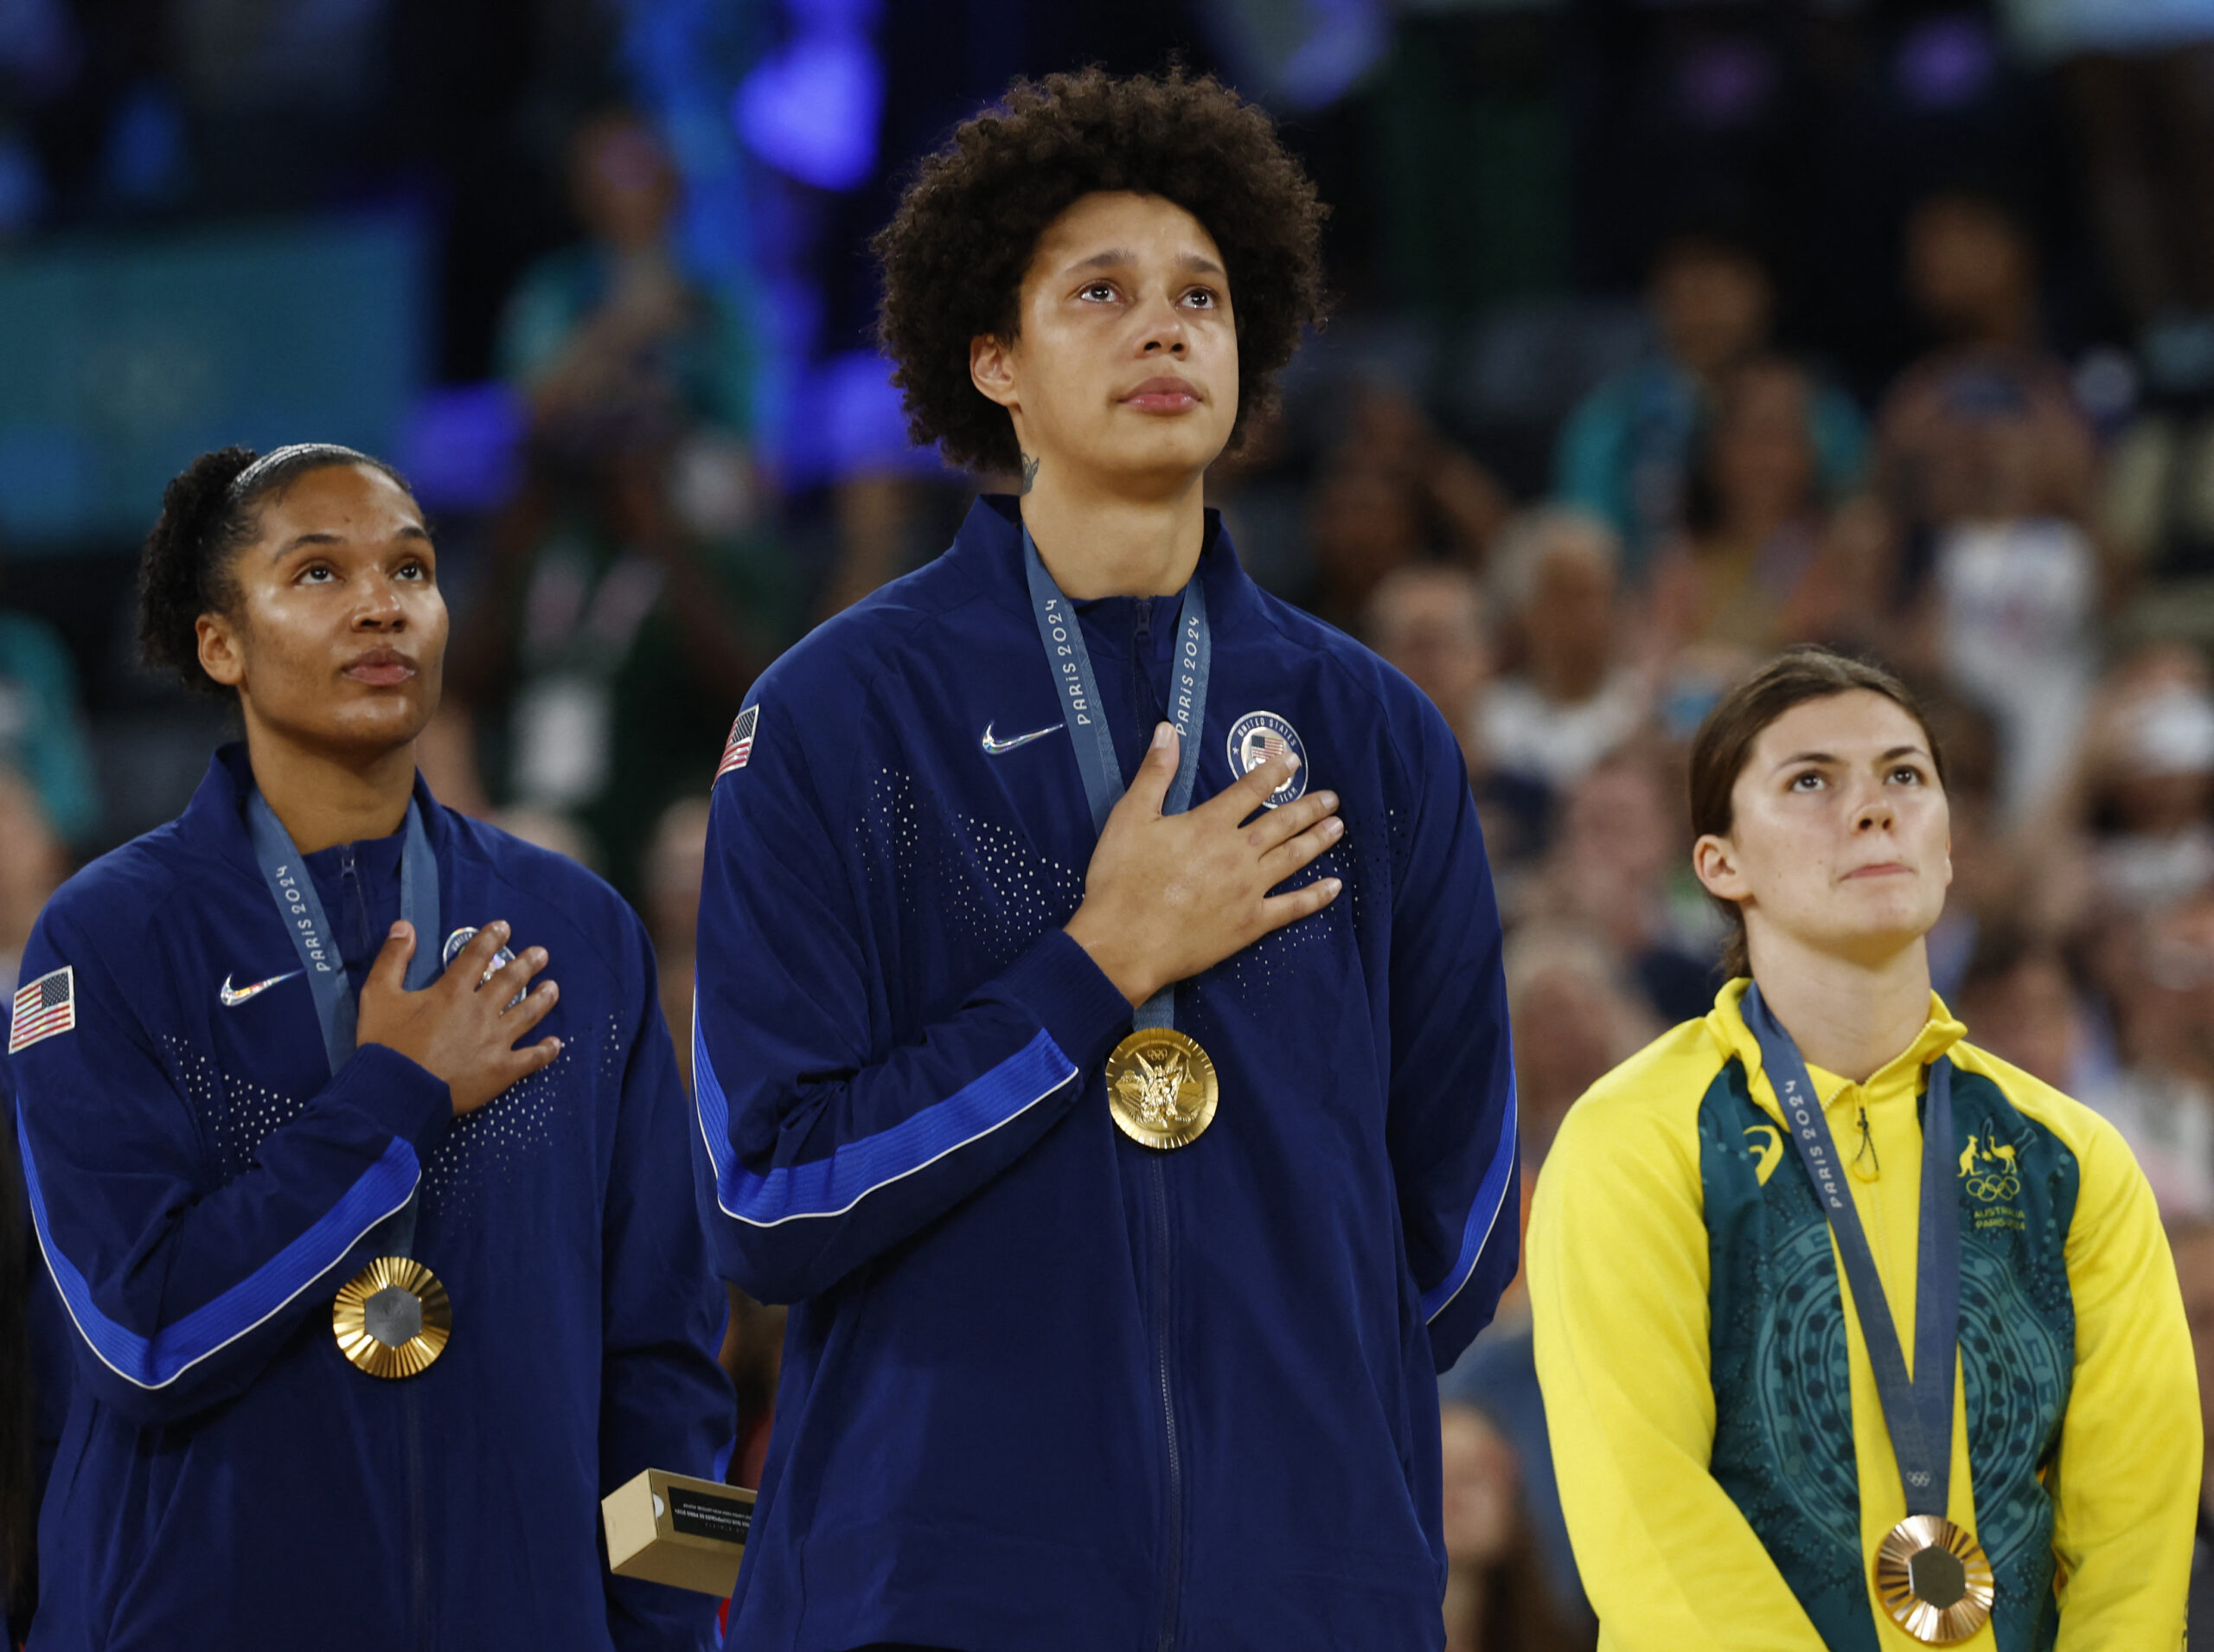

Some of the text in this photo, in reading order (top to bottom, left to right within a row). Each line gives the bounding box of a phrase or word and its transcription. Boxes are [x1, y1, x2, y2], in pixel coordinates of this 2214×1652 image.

[1045, 599, 1072, 656] 2024
[1183, 616, 1200, 670] 2024
[1237, 717, 1297, 746] UNITED STATES
[276, 865, 307, 914] 2024
[1785, 1080, 1816, 1140] 2024
